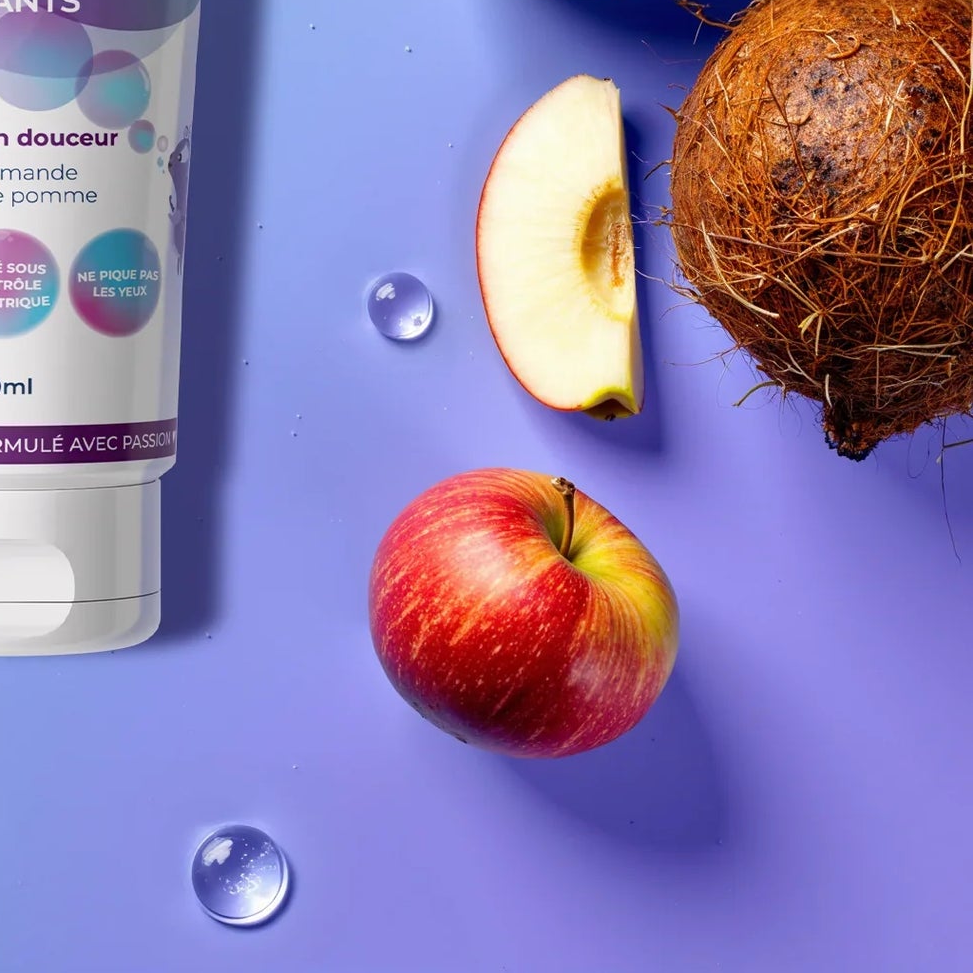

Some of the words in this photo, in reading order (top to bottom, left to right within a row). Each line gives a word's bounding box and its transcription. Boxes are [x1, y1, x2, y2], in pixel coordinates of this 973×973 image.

[17, 128, 118, 147] douceur
[11, 190, 98, 207] pomme
[6, 263, 47, 275] SOUS
[77, 271, 96, 283] NE
[99, 269, 137, 282] PIQUE
[139, 270, 159, 281] PAS
[93, 286, 116, 297] LES
[118, 285, 147, 297] YEUX
[69, 435, 118, 452] AVEC
[122, 432, 171, 451] PASSION
